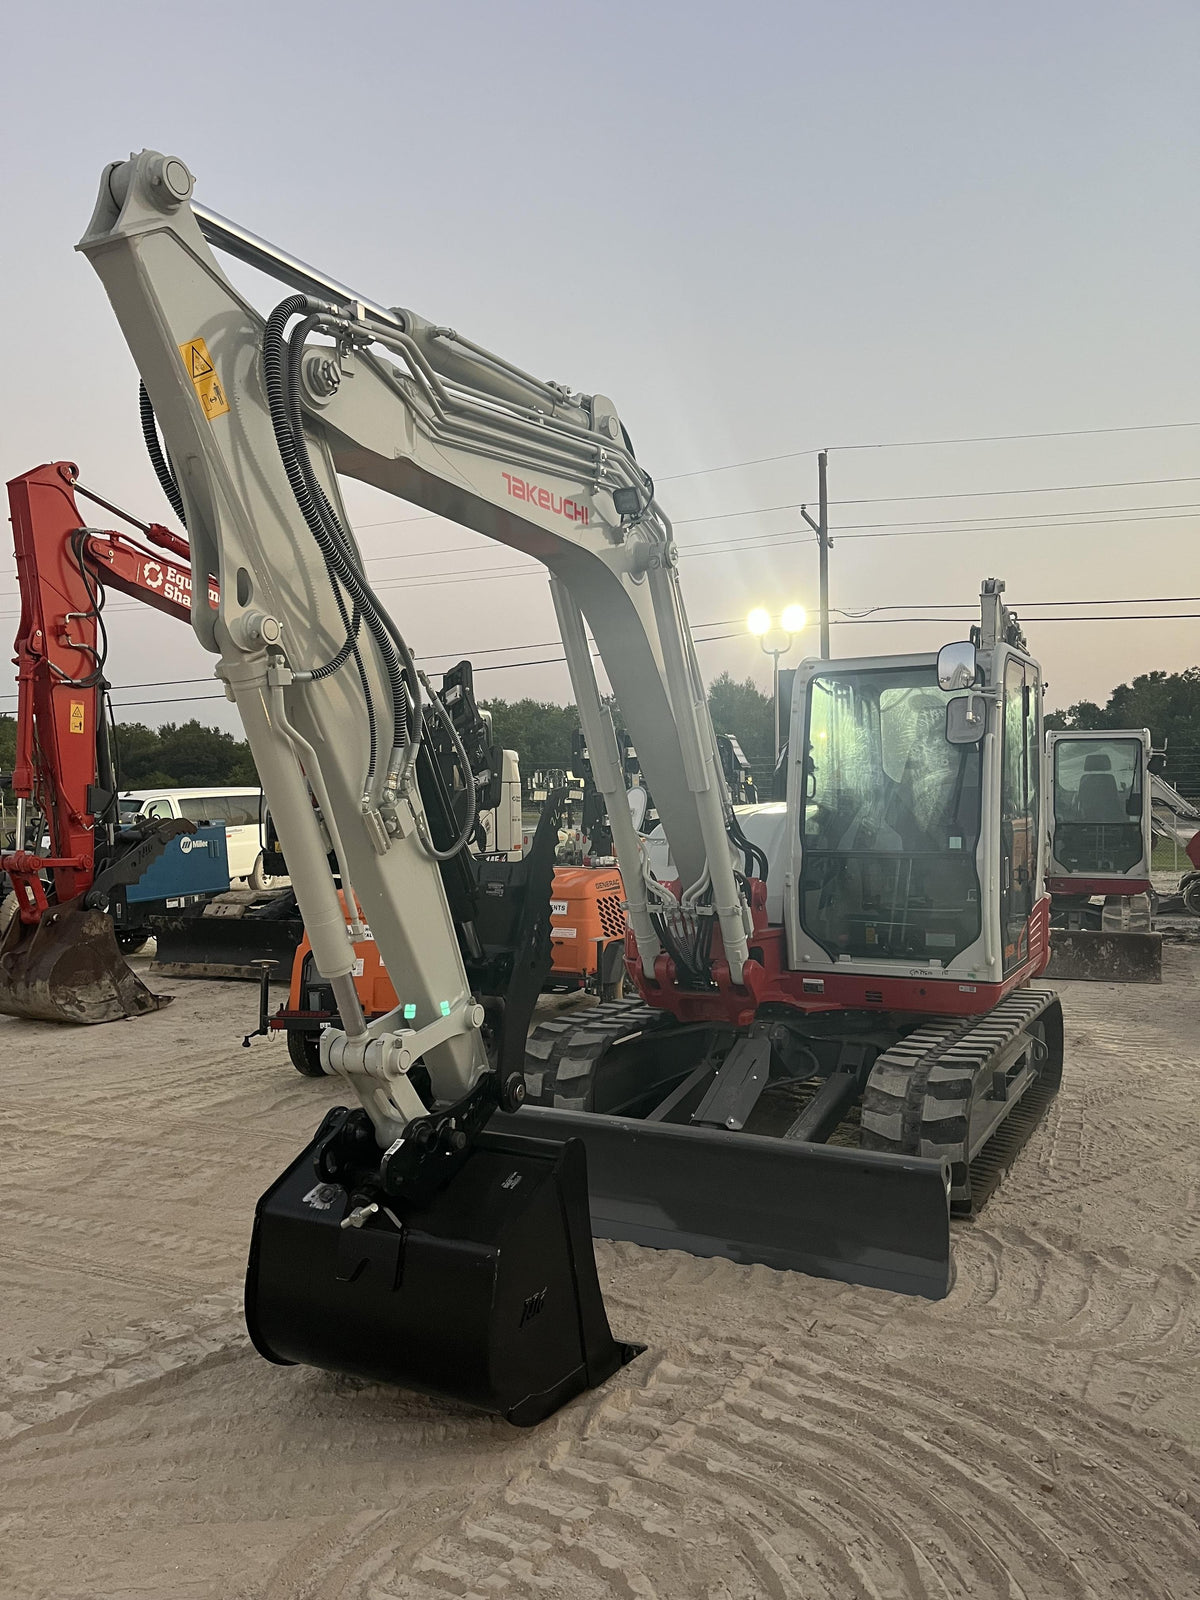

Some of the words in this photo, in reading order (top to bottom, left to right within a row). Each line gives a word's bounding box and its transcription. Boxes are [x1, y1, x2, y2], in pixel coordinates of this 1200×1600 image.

[164, 583, 192, 606] Sha
[192, 840, 208, 848] Miller
[595, 879, 620, 889] GENERAC
